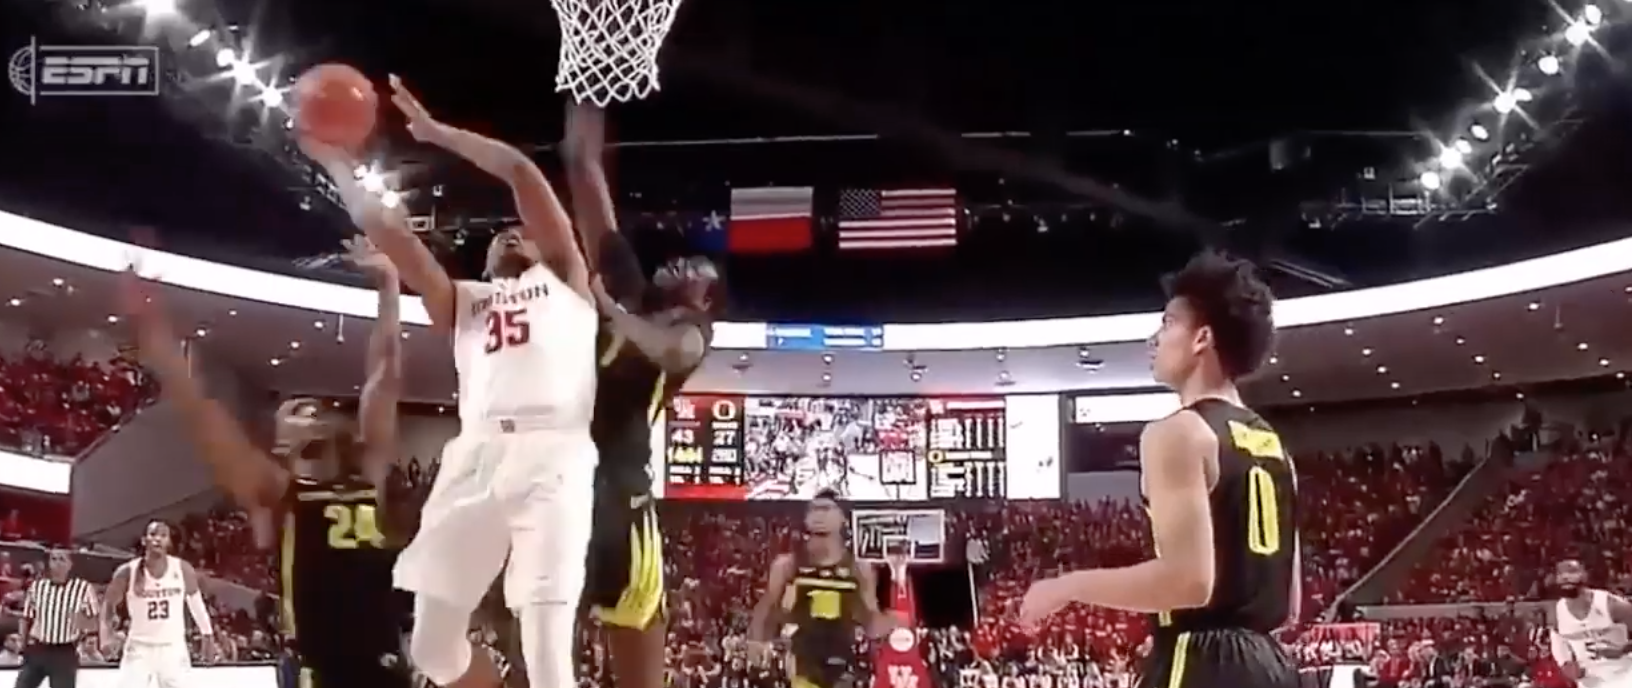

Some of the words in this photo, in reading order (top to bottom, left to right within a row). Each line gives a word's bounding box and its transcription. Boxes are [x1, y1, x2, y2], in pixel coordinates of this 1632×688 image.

[485, 309, 530, 354] 35
[671, 429, 694, 443] 43
[713, 430, 735, 446] 27
[1248, 465, 1279, 554] 0
[324, 504, 384, 549] 24
[148, 600, 169, 620] 23
